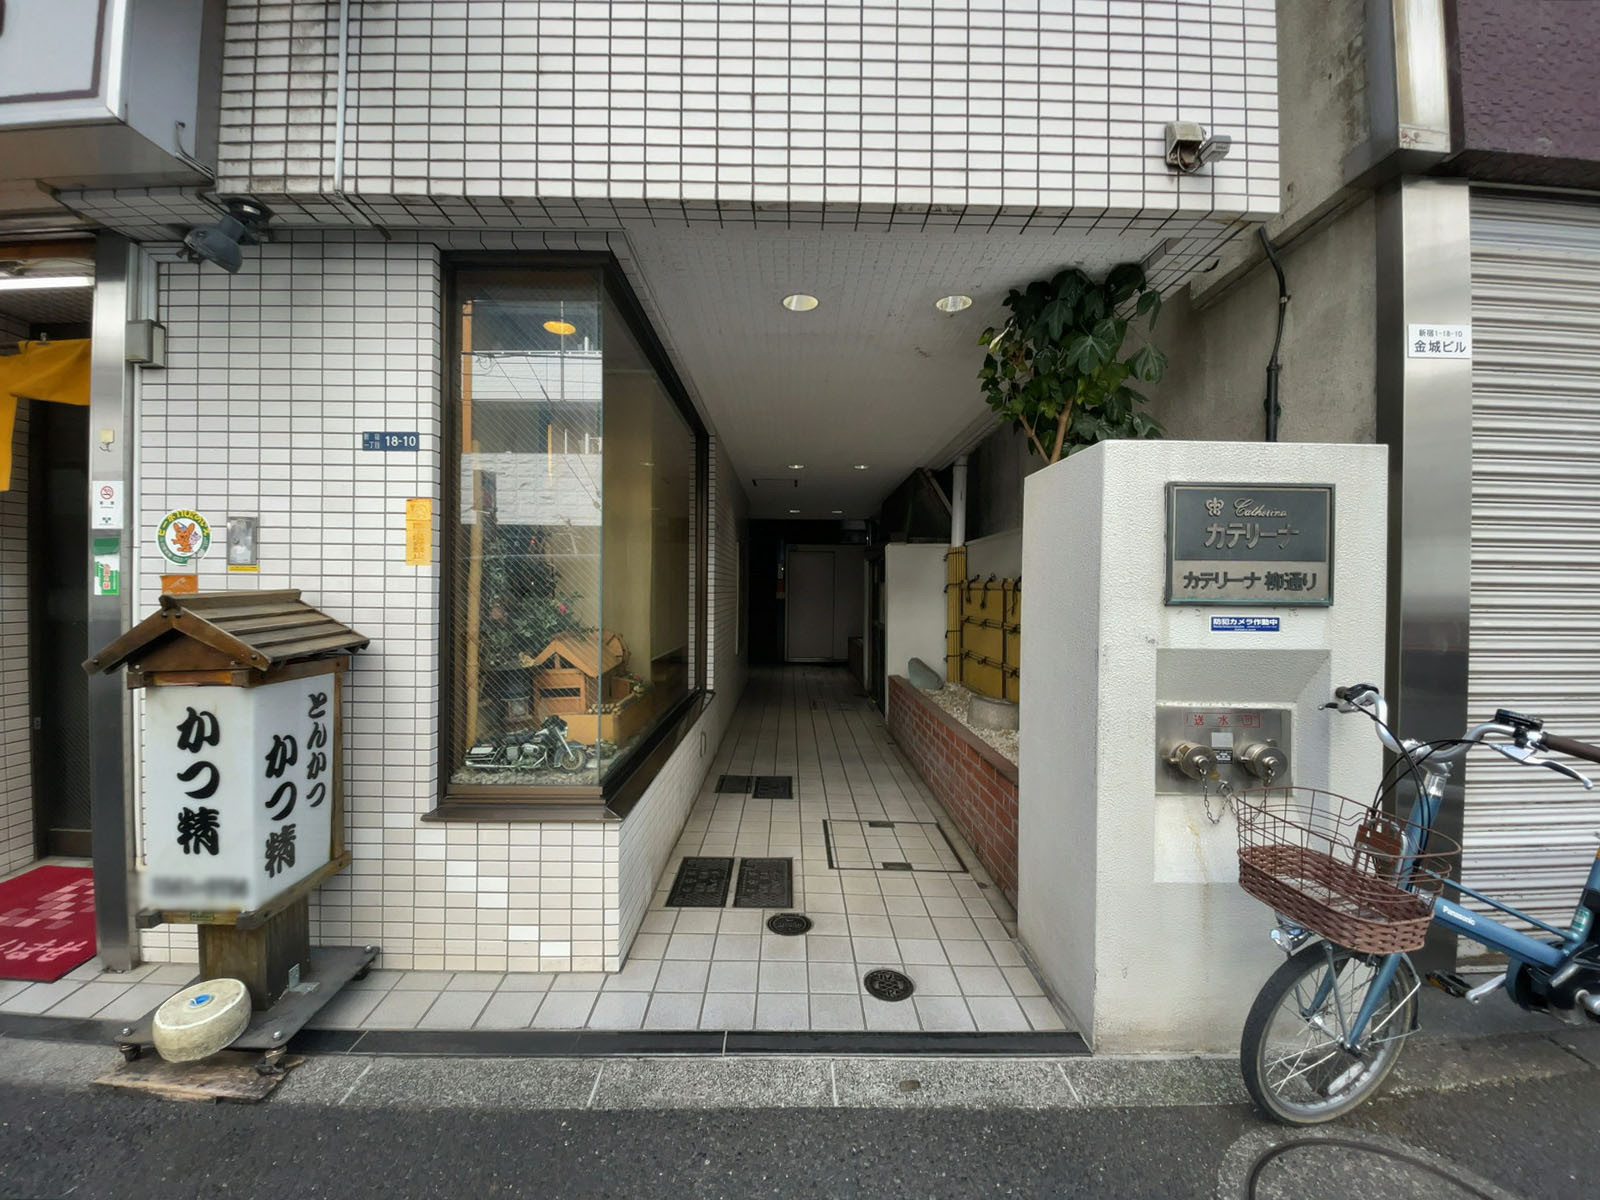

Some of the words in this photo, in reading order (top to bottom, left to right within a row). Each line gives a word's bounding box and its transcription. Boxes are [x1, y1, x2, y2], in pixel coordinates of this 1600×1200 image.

[1414, 340, 1467, 353] 金城ビル
[385, 435, 416, 447] 18-10
[1204, 522, 1300, 549] カテリーナ
[1183, 570, 1262, 591] カテリーナ
[1264, 570, 1318, 592] 柳通り
[176, 706, 221, 857] かつ精
[265, 734, 299, 879] かつ精
